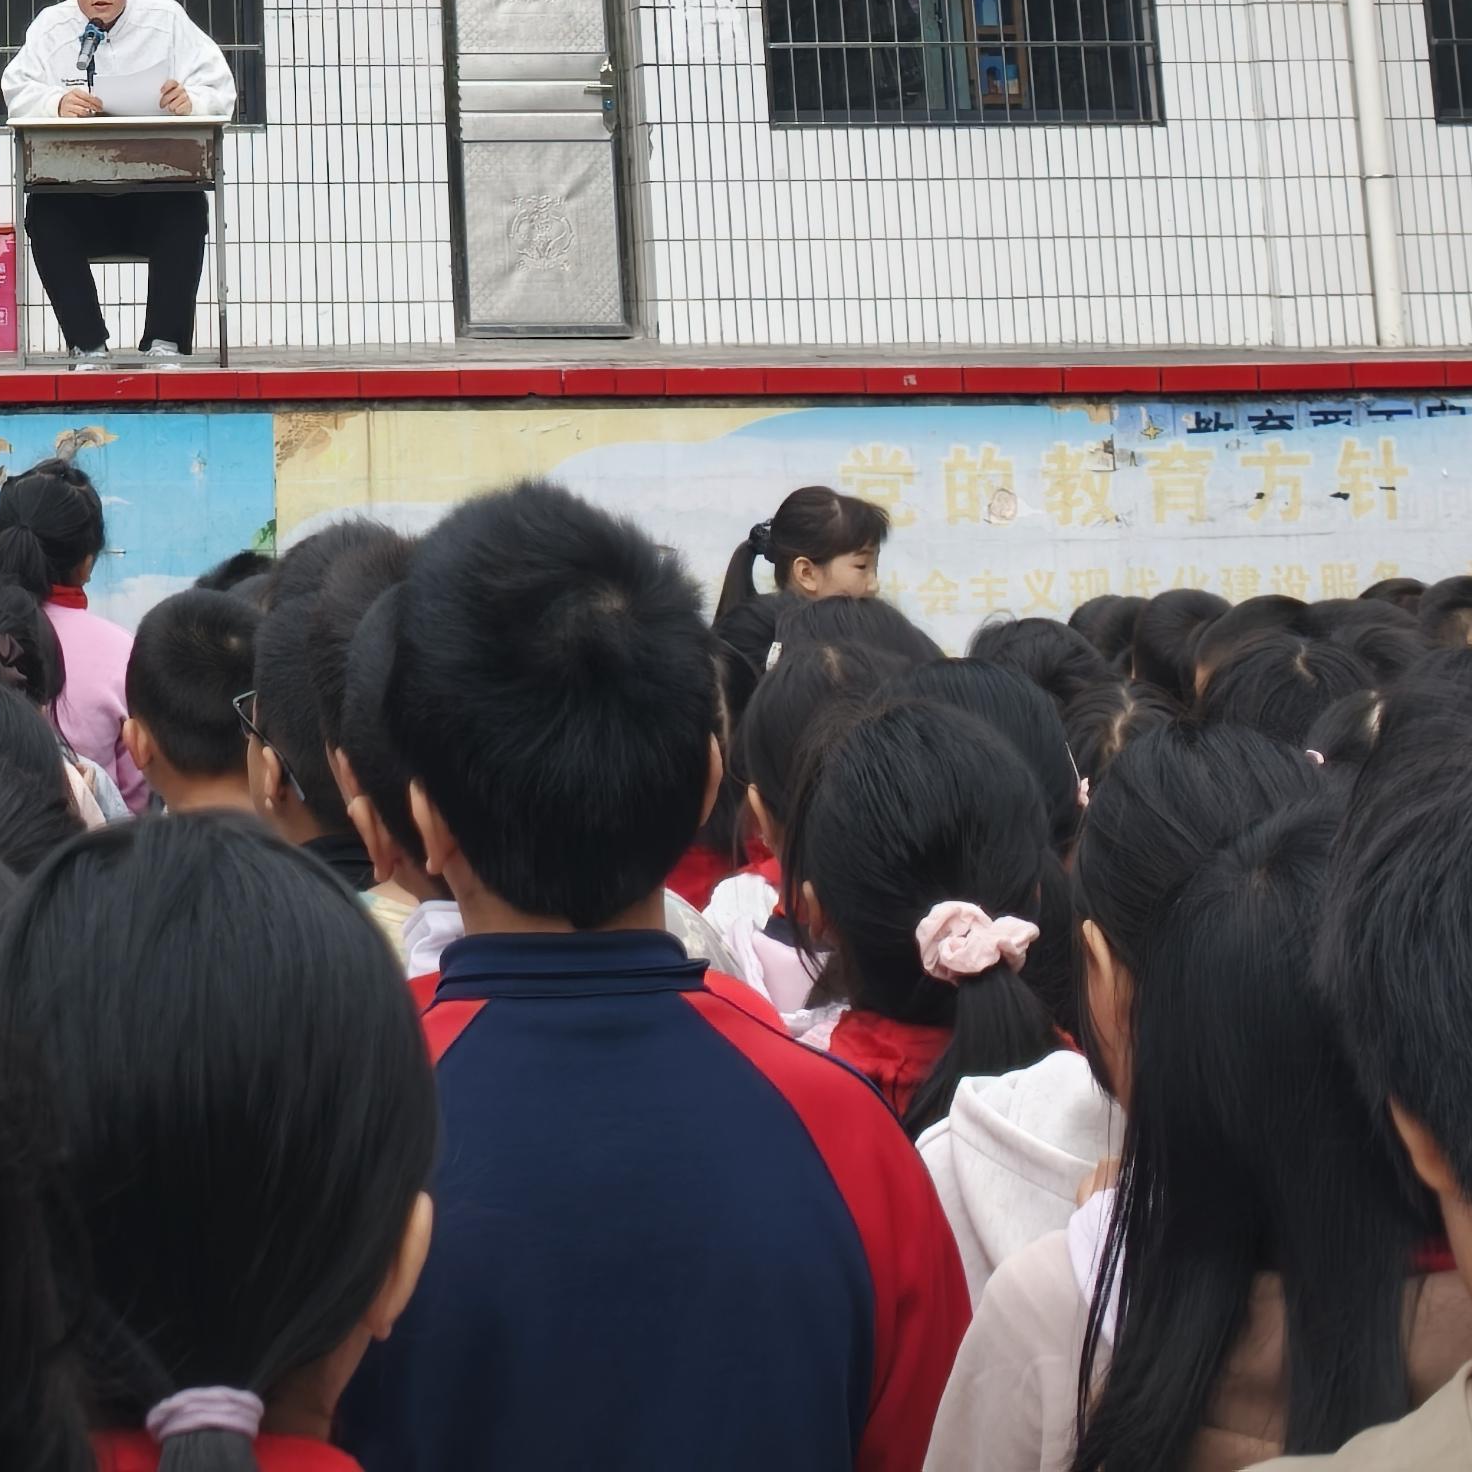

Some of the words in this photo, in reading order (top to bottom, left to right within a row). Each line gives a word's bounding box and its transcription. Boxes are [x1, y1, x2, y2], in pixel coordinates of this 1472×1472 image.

[839, 437, 1410, 527] 党的教育方针
